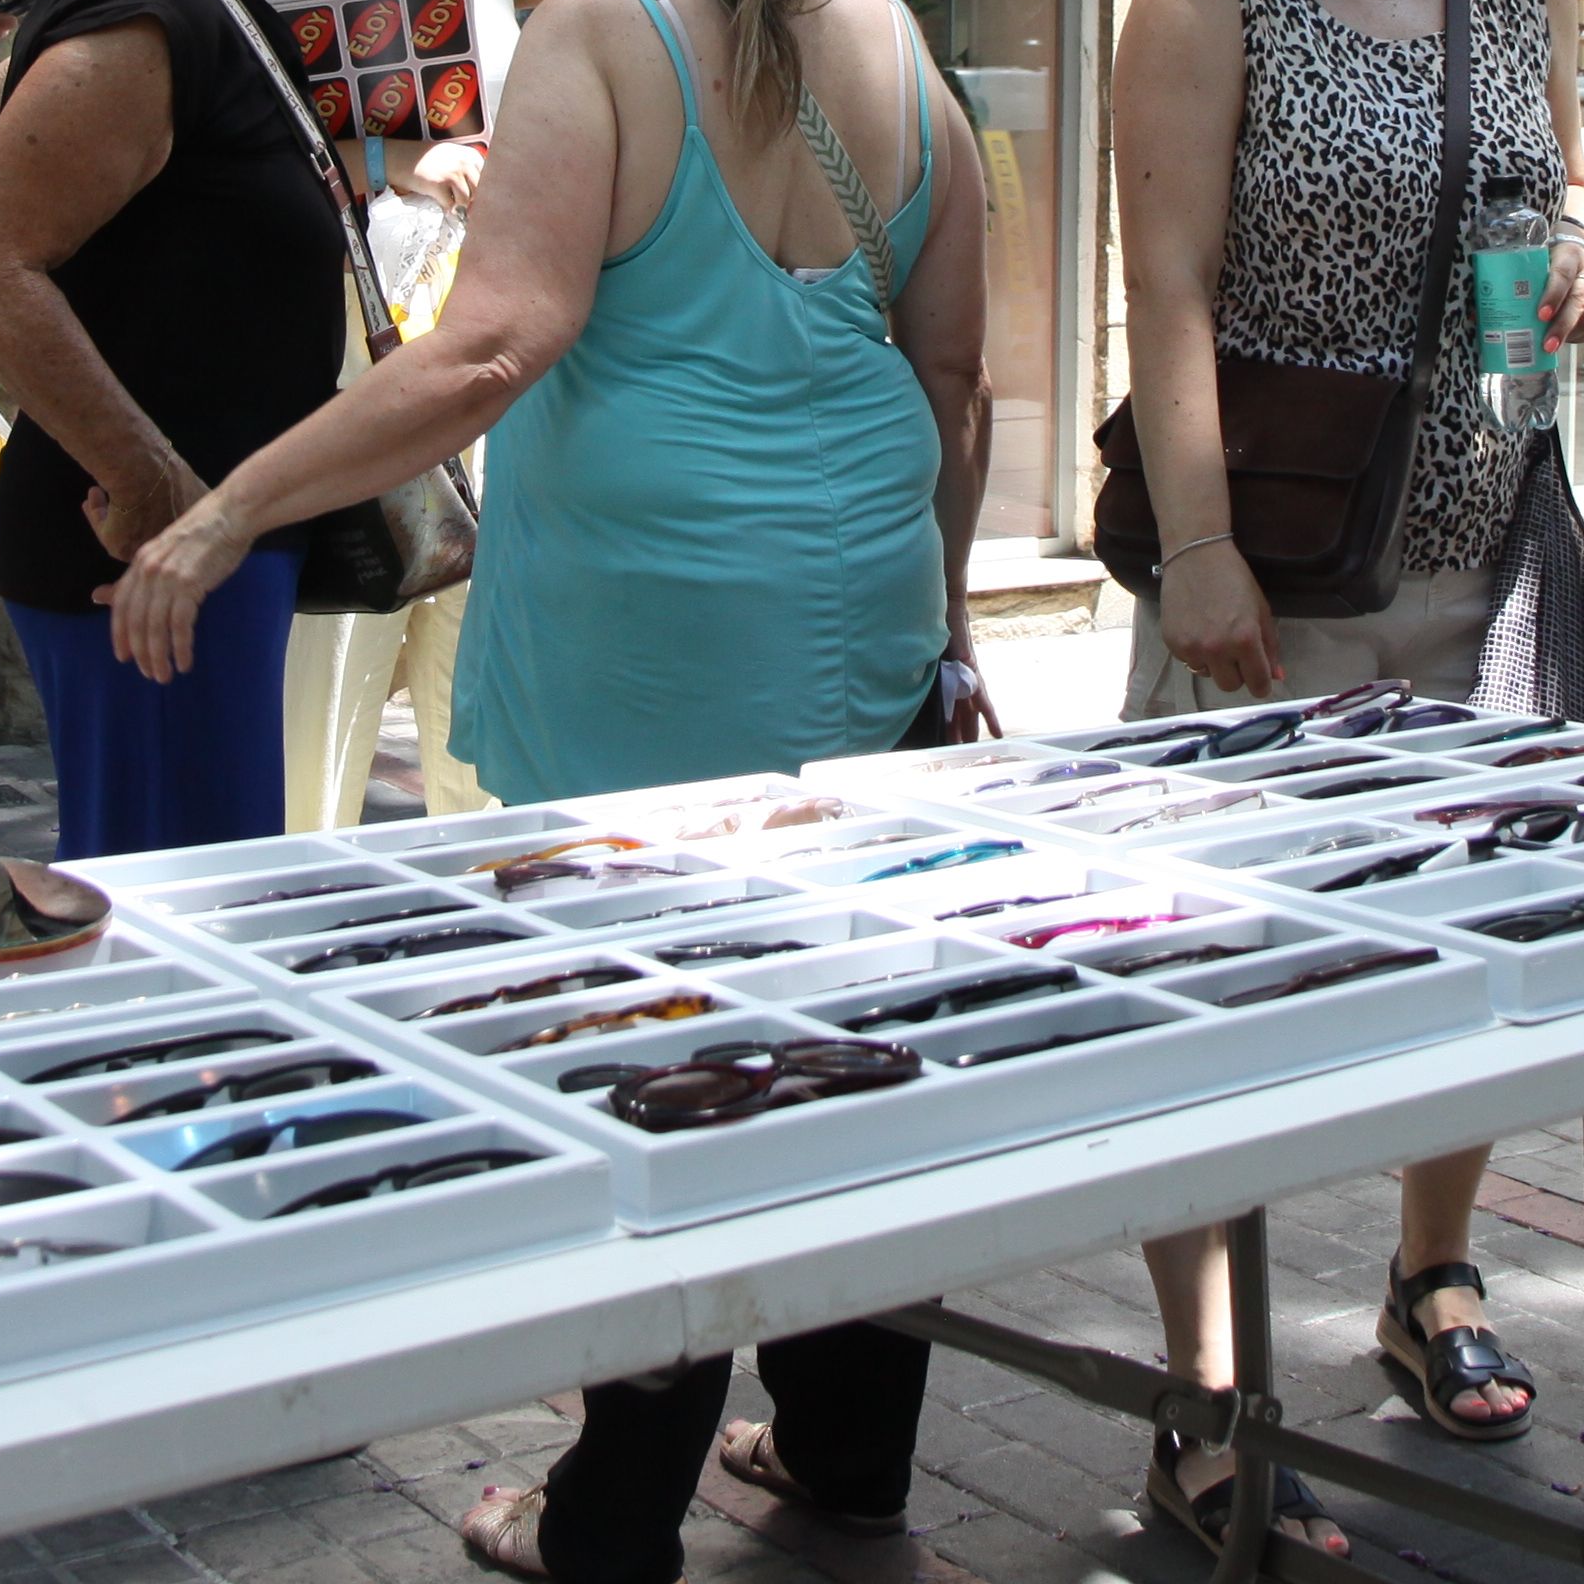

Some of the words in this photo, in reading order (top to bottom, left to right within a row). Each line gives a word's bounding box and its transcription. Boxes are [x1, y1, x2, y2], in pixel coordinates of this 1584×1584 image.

[300, 11, 328, 54] LOY
[346, 1, 396, 58] ELOY
[362, 73, 412, 137] ELOY
[425, 66, 473, 128] ELOY
